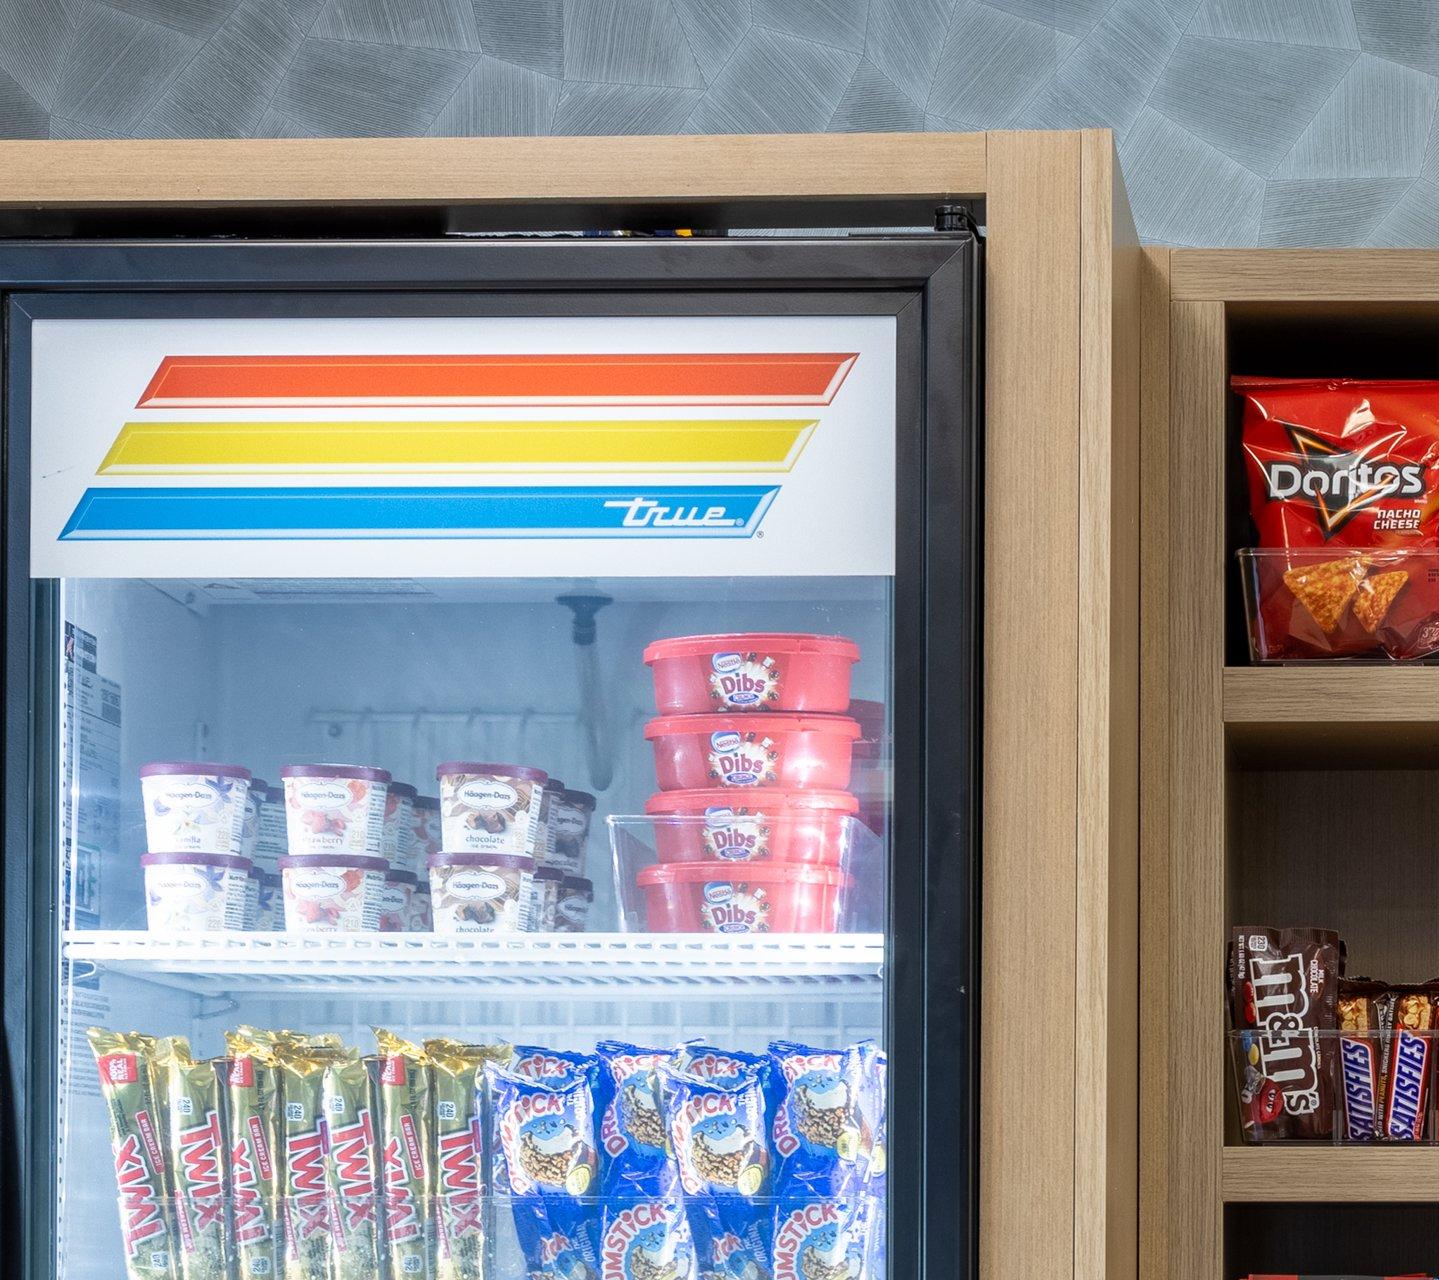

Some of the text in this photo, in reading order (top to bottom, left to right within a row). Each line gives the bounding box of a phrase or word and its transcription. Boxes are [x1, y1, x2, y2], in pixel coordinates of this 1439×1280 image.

[1269, 463, 1423, 499] Doritos
[605, 496, 736, 529] true
[1377, 509, 1421, 519] NACHO
[1373, 519, 1420, 530] CHEESE
[720, 673, 766, 695] Dibs
[719, 753, 763, 776] Dibs
[712, 827, 756, 849] Dibs
[710, 903, 755, 927] Dibs
[180, 1111, 225, 1233] TWIX
[115, 1135, 166, 1257] TWIX
